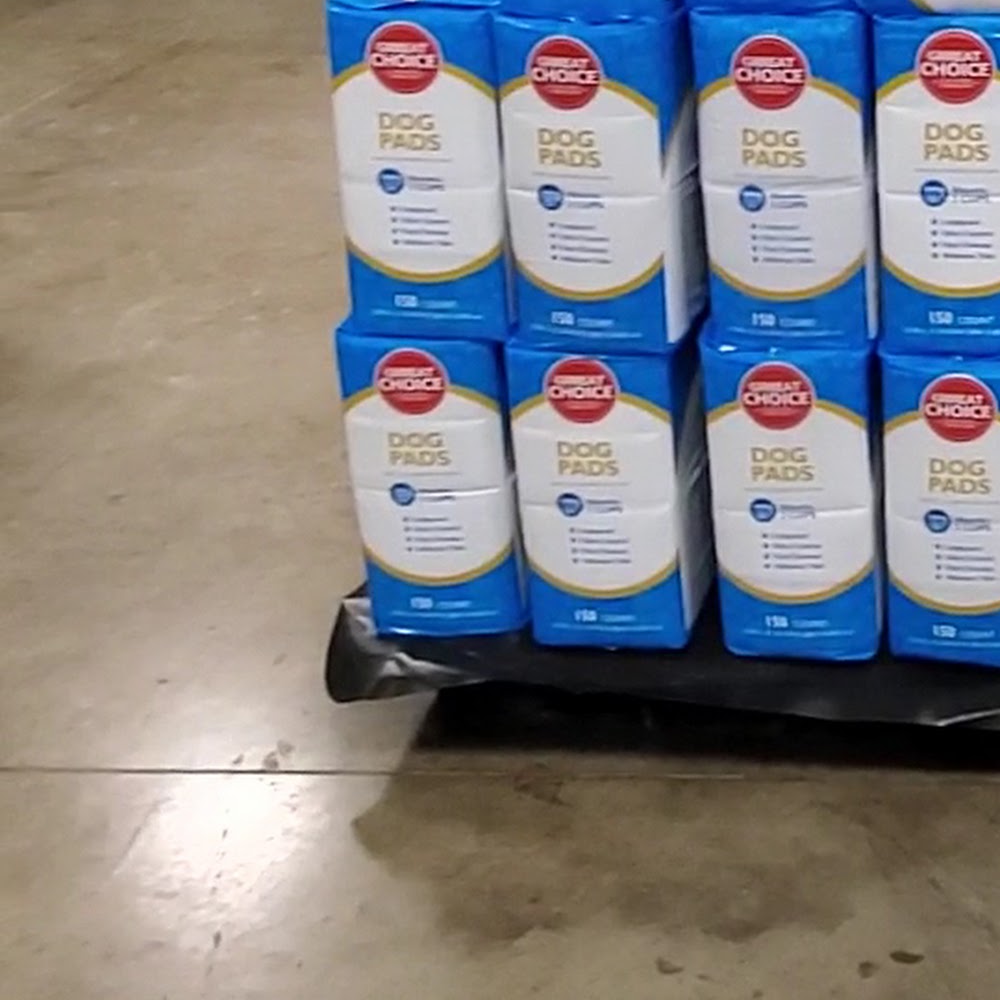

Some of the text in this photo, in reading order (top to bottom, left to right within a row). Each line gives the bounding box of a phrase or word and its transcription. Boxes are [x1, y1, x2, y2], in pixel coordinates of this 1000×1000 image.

[374, 42, 430, 53] GREAT
[370, 53, 438, 69] CHOICE
[537, 56, 591, 68] GREAT
[742, 56, 797, 67] GREAT
[926, 51, 983, 62] GREAT
[532, 67, 600, 84] CHOICE
[735, 67, 806, 84] CHOICE
[920, 62, 992, 77] CHOICE
[378, 112, 435, 130] DOG
[537, 128, 595, 147] DOG
[742, 128, 799, 147] DOG
[924, 123, 983, 141] DOG
[379, 133, 441, 151] PADS
[538, 149, 602, 168] PADS
[742, 149, 807, 168] PADS
[924, 144, 990, 162] PADS
[394, 294, 418, 308] 150
[551, 311, 575, 325] 150
[752, 312, 777, 327] 150
[929, 311, 953, 325] 150
[384, 367, 434, 377] GREAT
[553, 374, 606, 385] GREAT
[378, 377, 444, 391] CHOICE
[748, 381, 802, 391] GREAT
[549, 385, 616, 400] CHOICE
[743, 391, 812, 406] CHOICE
[931, 393, 984, 404] GREAT
[925, 403, 993, 419] CHOICE
[388, 432, 443, 448] DOG
[556, 441, 612, 458] DOG
[751, 447, 808, 463] DOG
[389, 450, 451, 466] PADS
[557, 459, 620, 476] PADS
[751, 465, 816, 481] PADS
[929, 457, 986, 476] DOG
[928, 477, 991, 495] PADS
[410, 597, 434, 609] 150
[573, 609, 598, 622] 150
[765, 615, 789, 628] 150
[932, 624, 957, 638] 150
